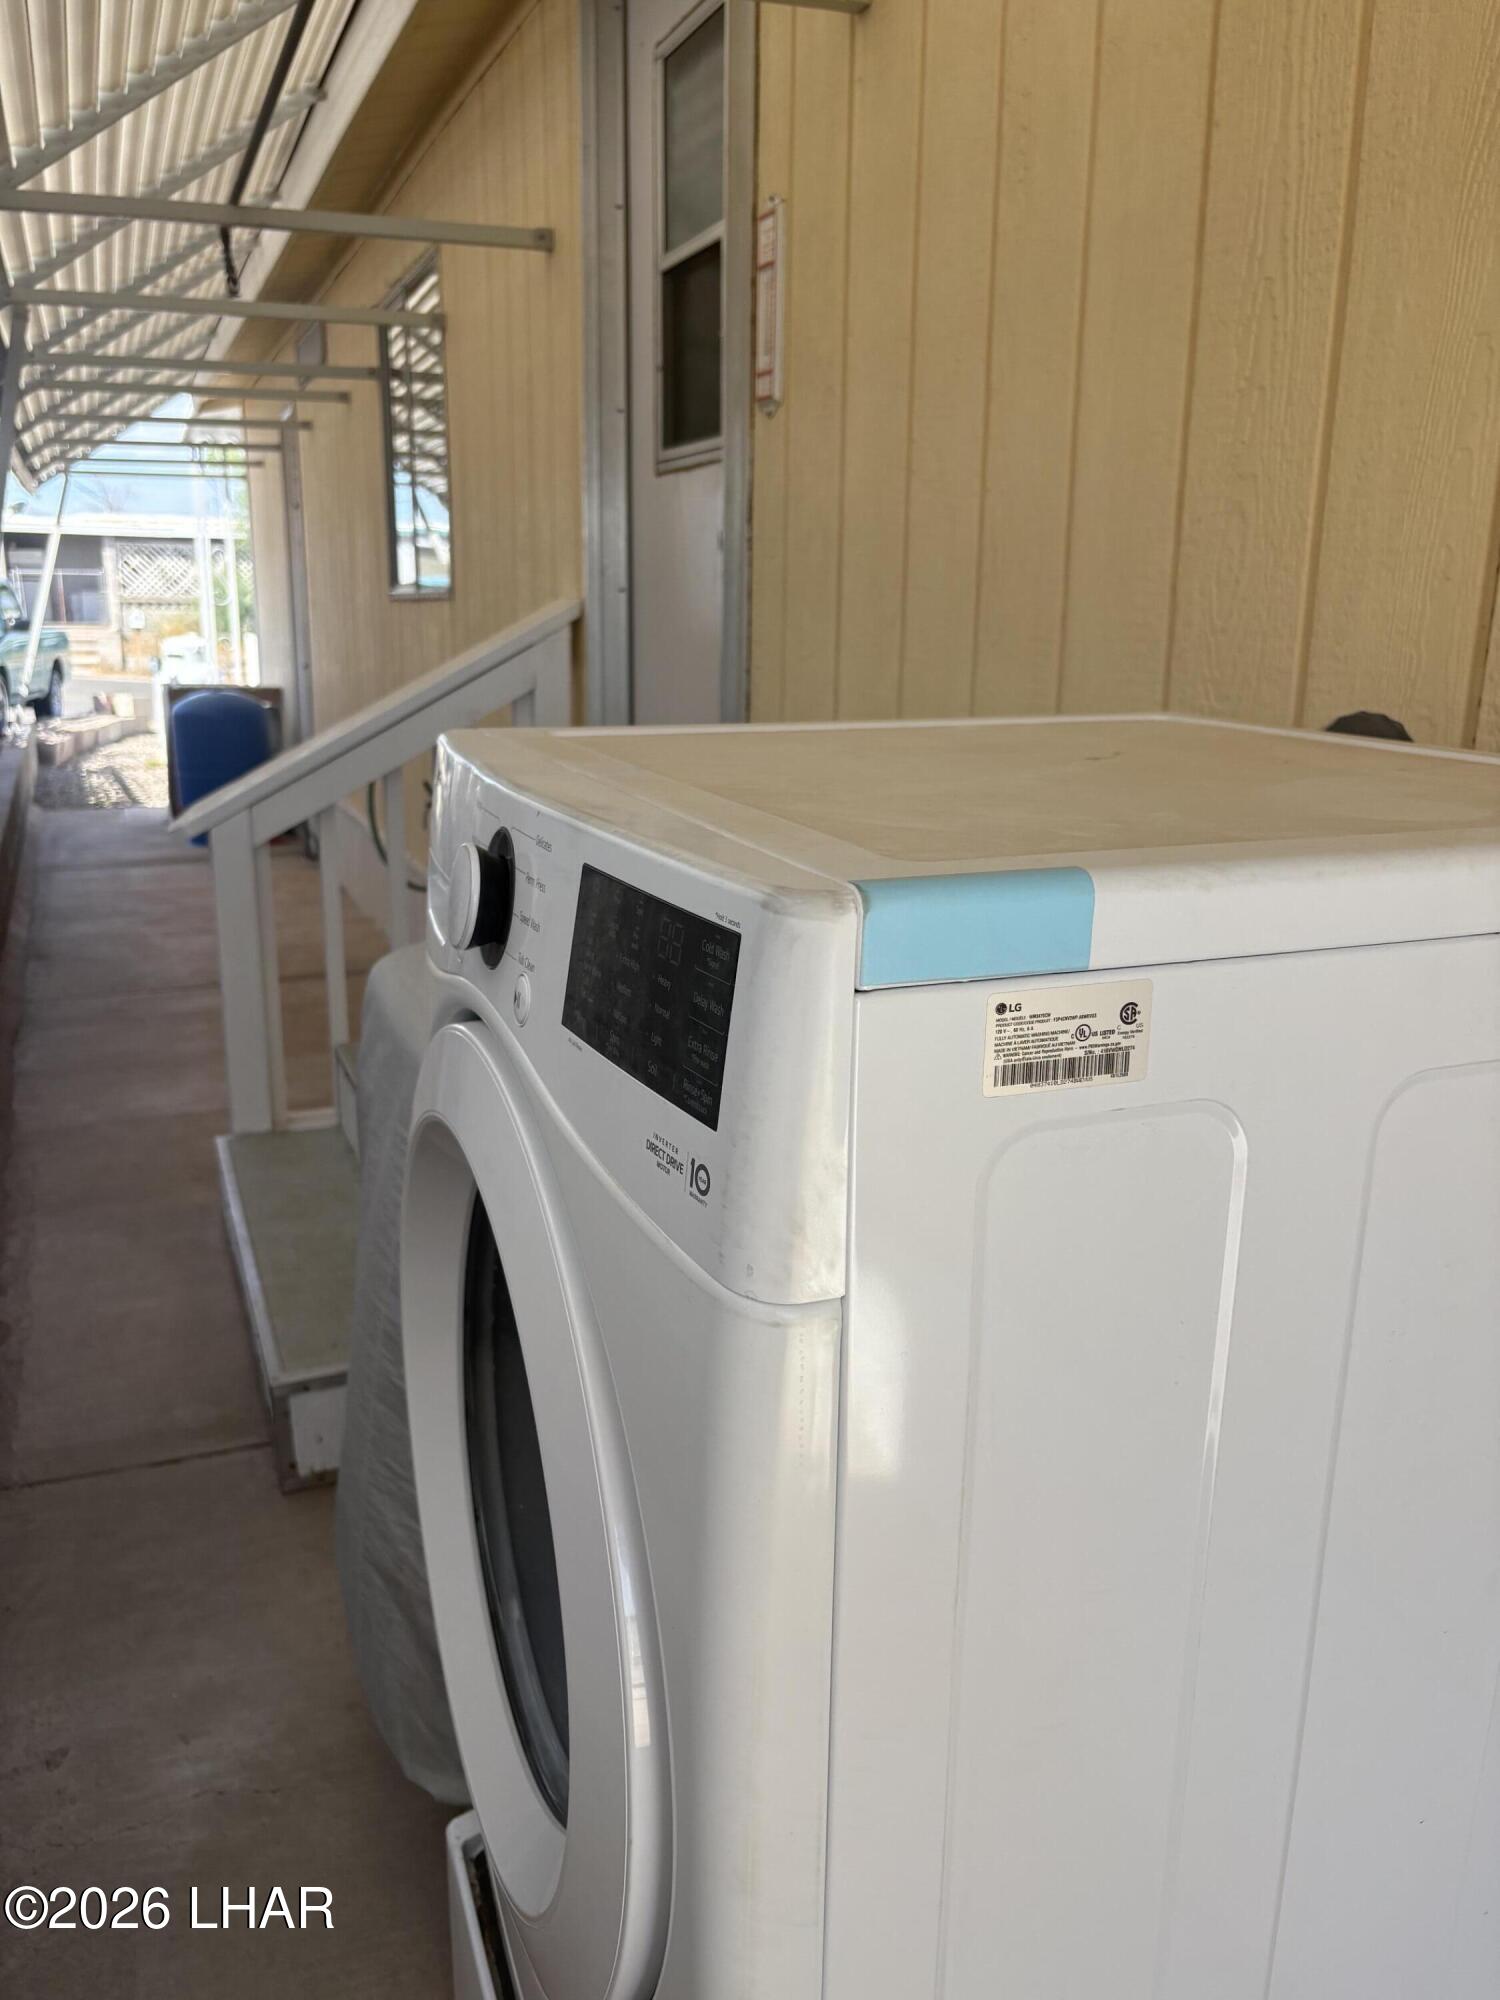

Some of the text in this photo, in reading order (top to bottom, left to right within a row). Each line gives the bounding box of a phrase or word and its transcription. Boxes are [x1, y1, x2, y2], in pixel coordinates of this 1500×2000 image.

[701, 939, 730, 961] Cold Wash
[693, 991, 724, 1017] Delay Wash
[1008, 1003, 1022, 1013] LG
[1100, 1029, 1116, 1037] LISTED
[687, 1035, 703, 1054] Extra
[702, 1044, 719, 1062] Rinse
[648, 1059, 658, 1077] Soil
[653, 1131, 679, 1155] INVERTER
[646, 1138, 685, 1176] DIRECT DRIVE
[690, 1157, 711, 1197] 10
